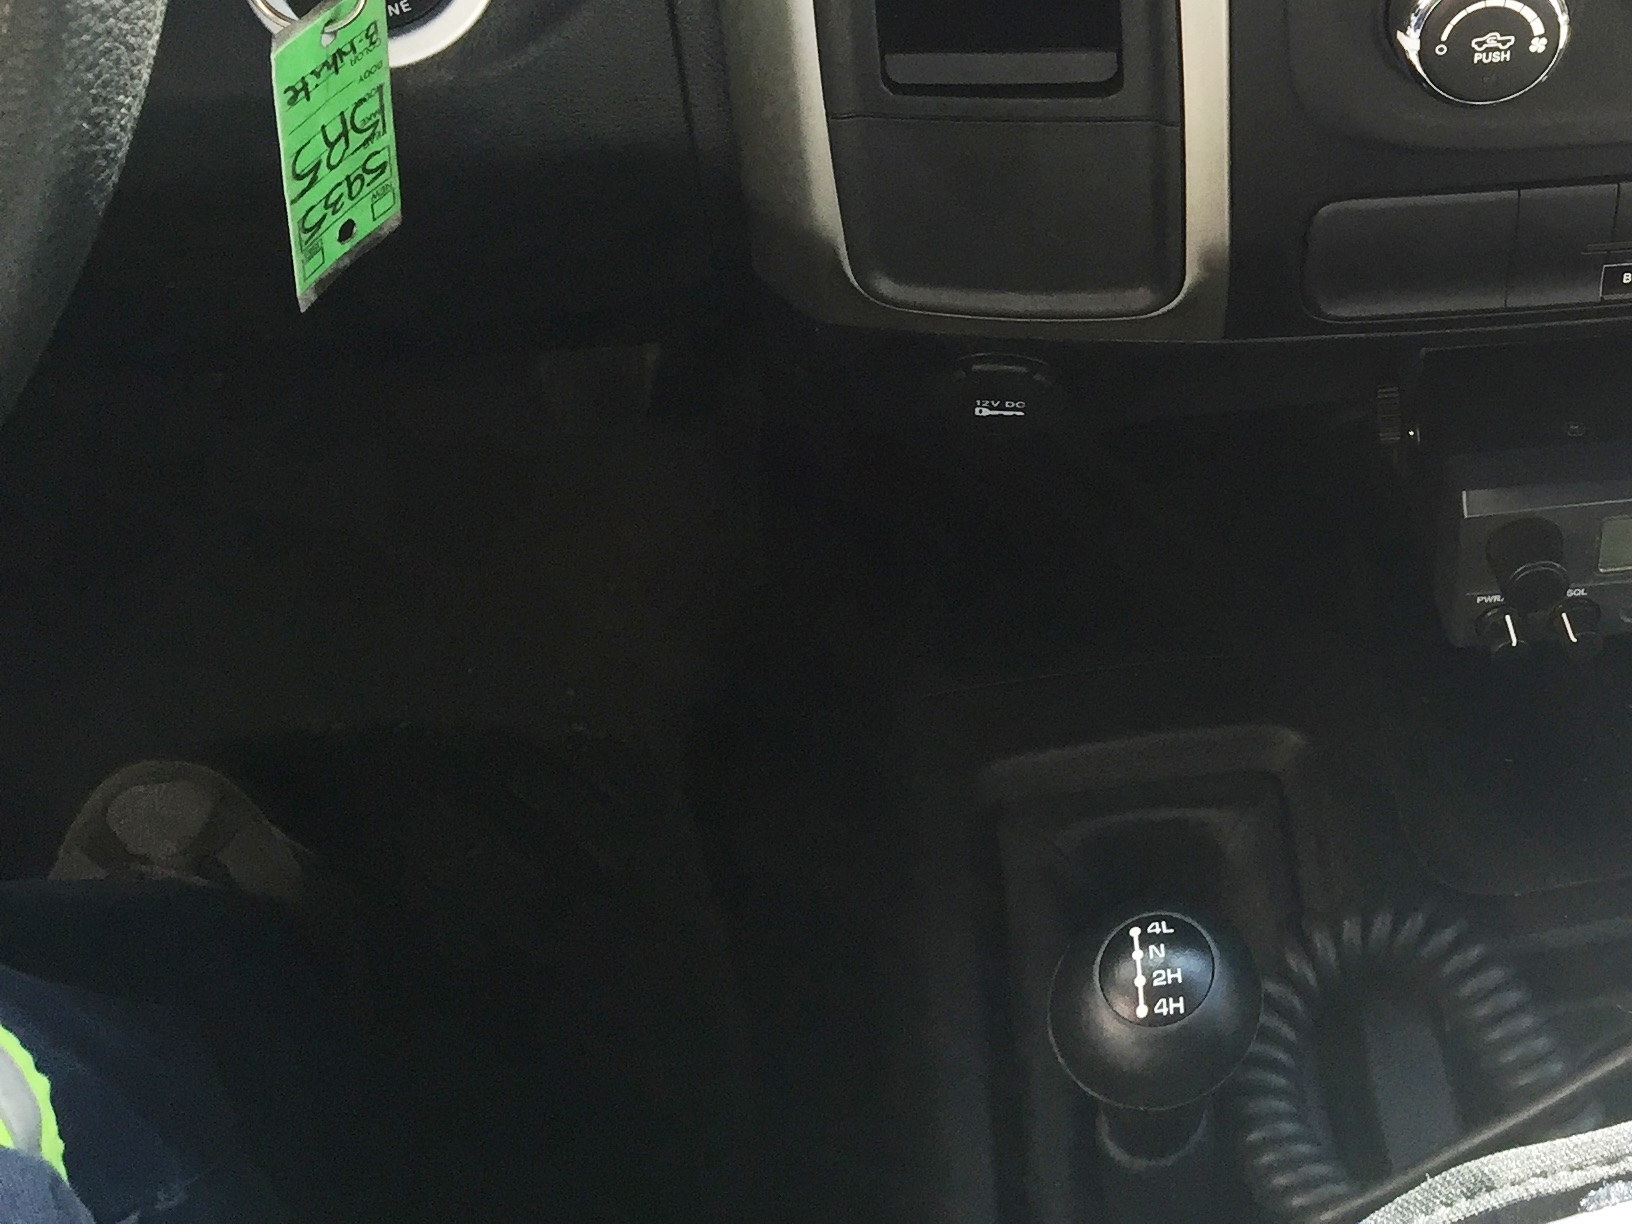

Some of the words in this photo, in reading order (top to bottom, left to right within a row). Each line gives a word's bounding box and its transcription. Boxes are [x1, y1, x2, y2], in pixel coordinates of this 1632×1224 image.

[1473, 50, 1511, 64] PUSH
[358, 60, 383, 83] BODY
[975, 399, 1000, 408] 12V
[1566, 588, 1588, 597] SQL
[1147, 920, 1174, 934] 4L
[1148, 943, 1165, 959] N
[1152, 967, 1182, 987] 2H
[1154, 996, 1184, 1016] 4H
